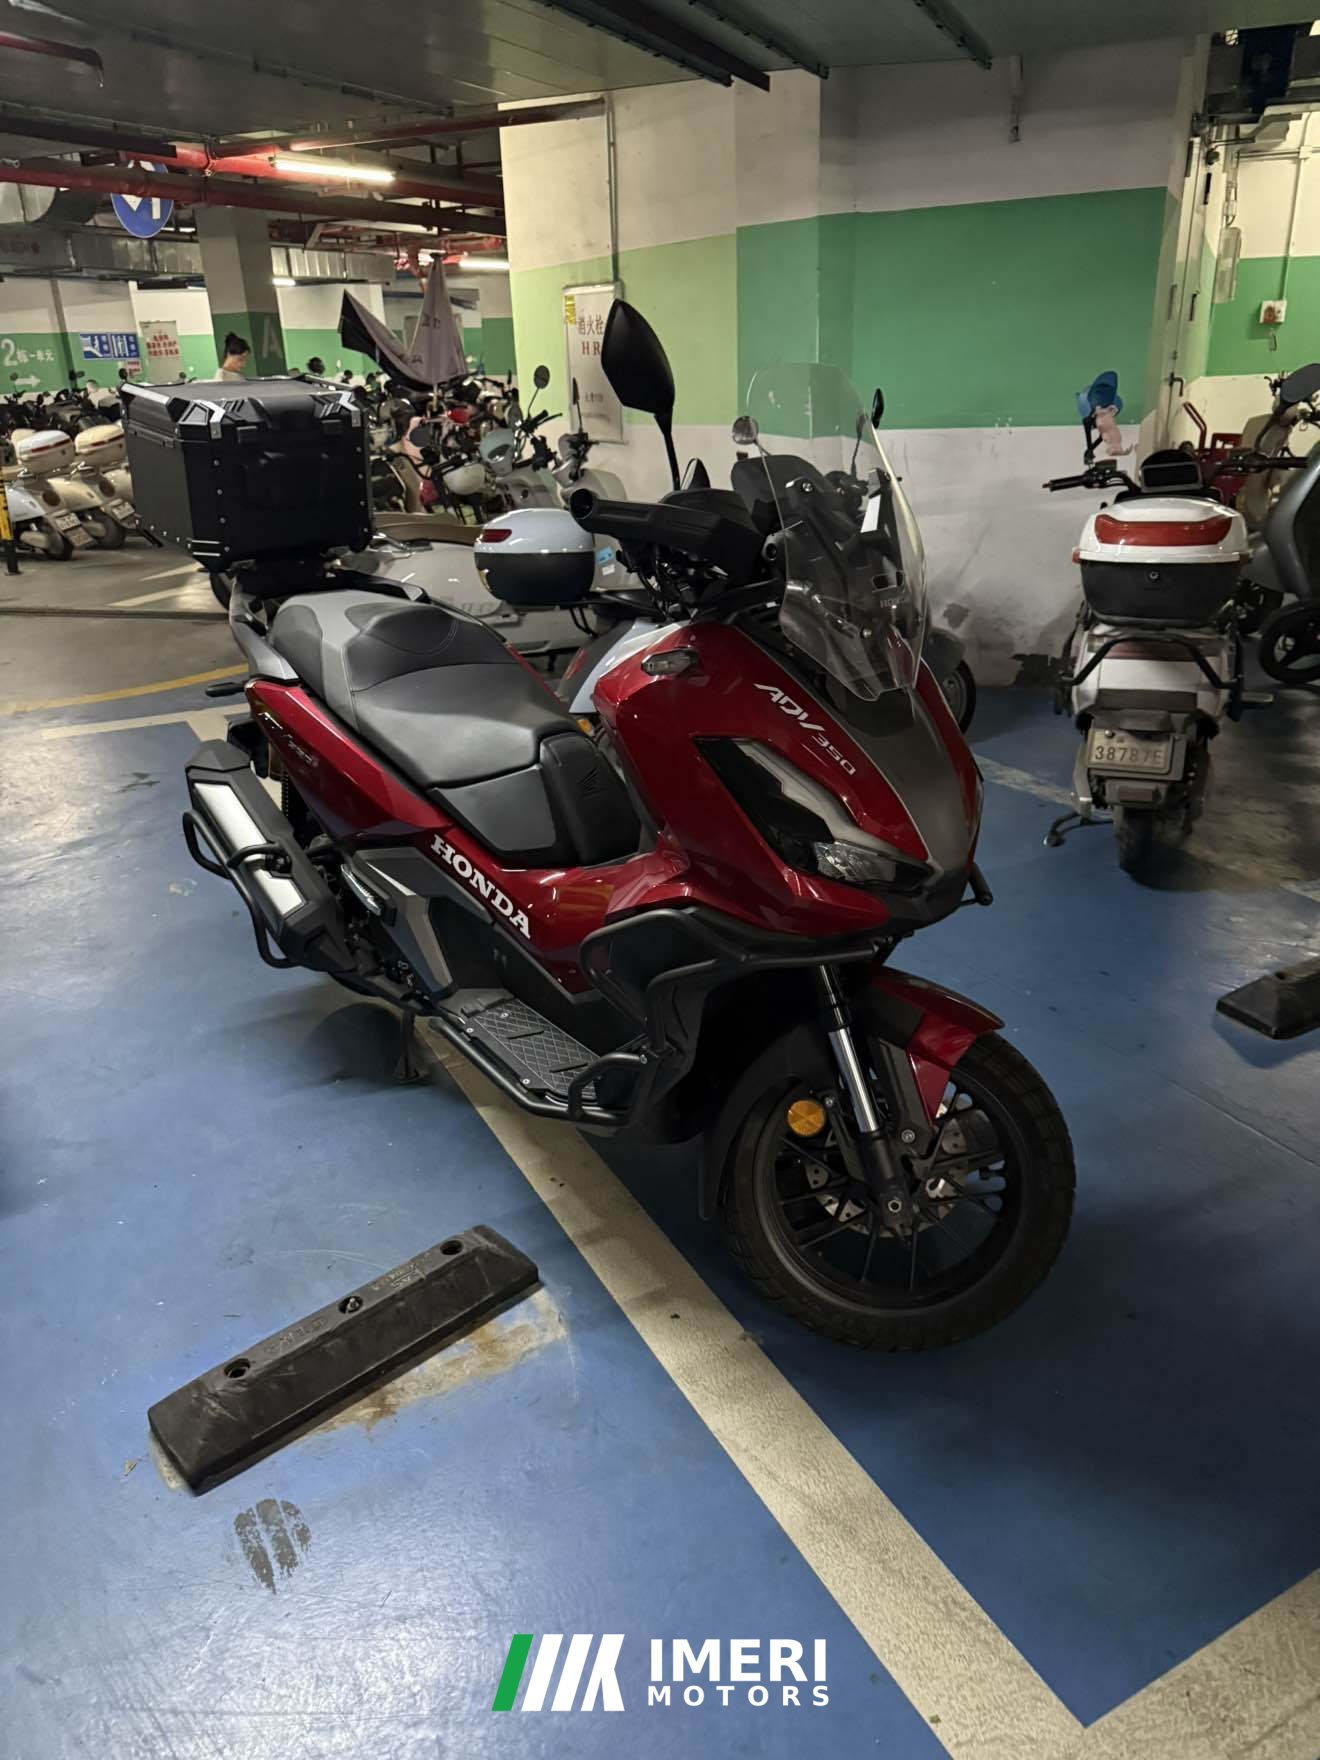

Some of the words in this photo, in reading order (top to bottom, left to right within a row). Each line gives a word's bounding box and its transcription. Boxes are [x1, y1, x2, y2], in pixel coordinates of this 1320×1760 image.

[263, 318, 283, 358] A
[753, 683, 826, 731] ADV
[811, 732, 856, 776] 350
[430, 833, 531, 940] HONDA
